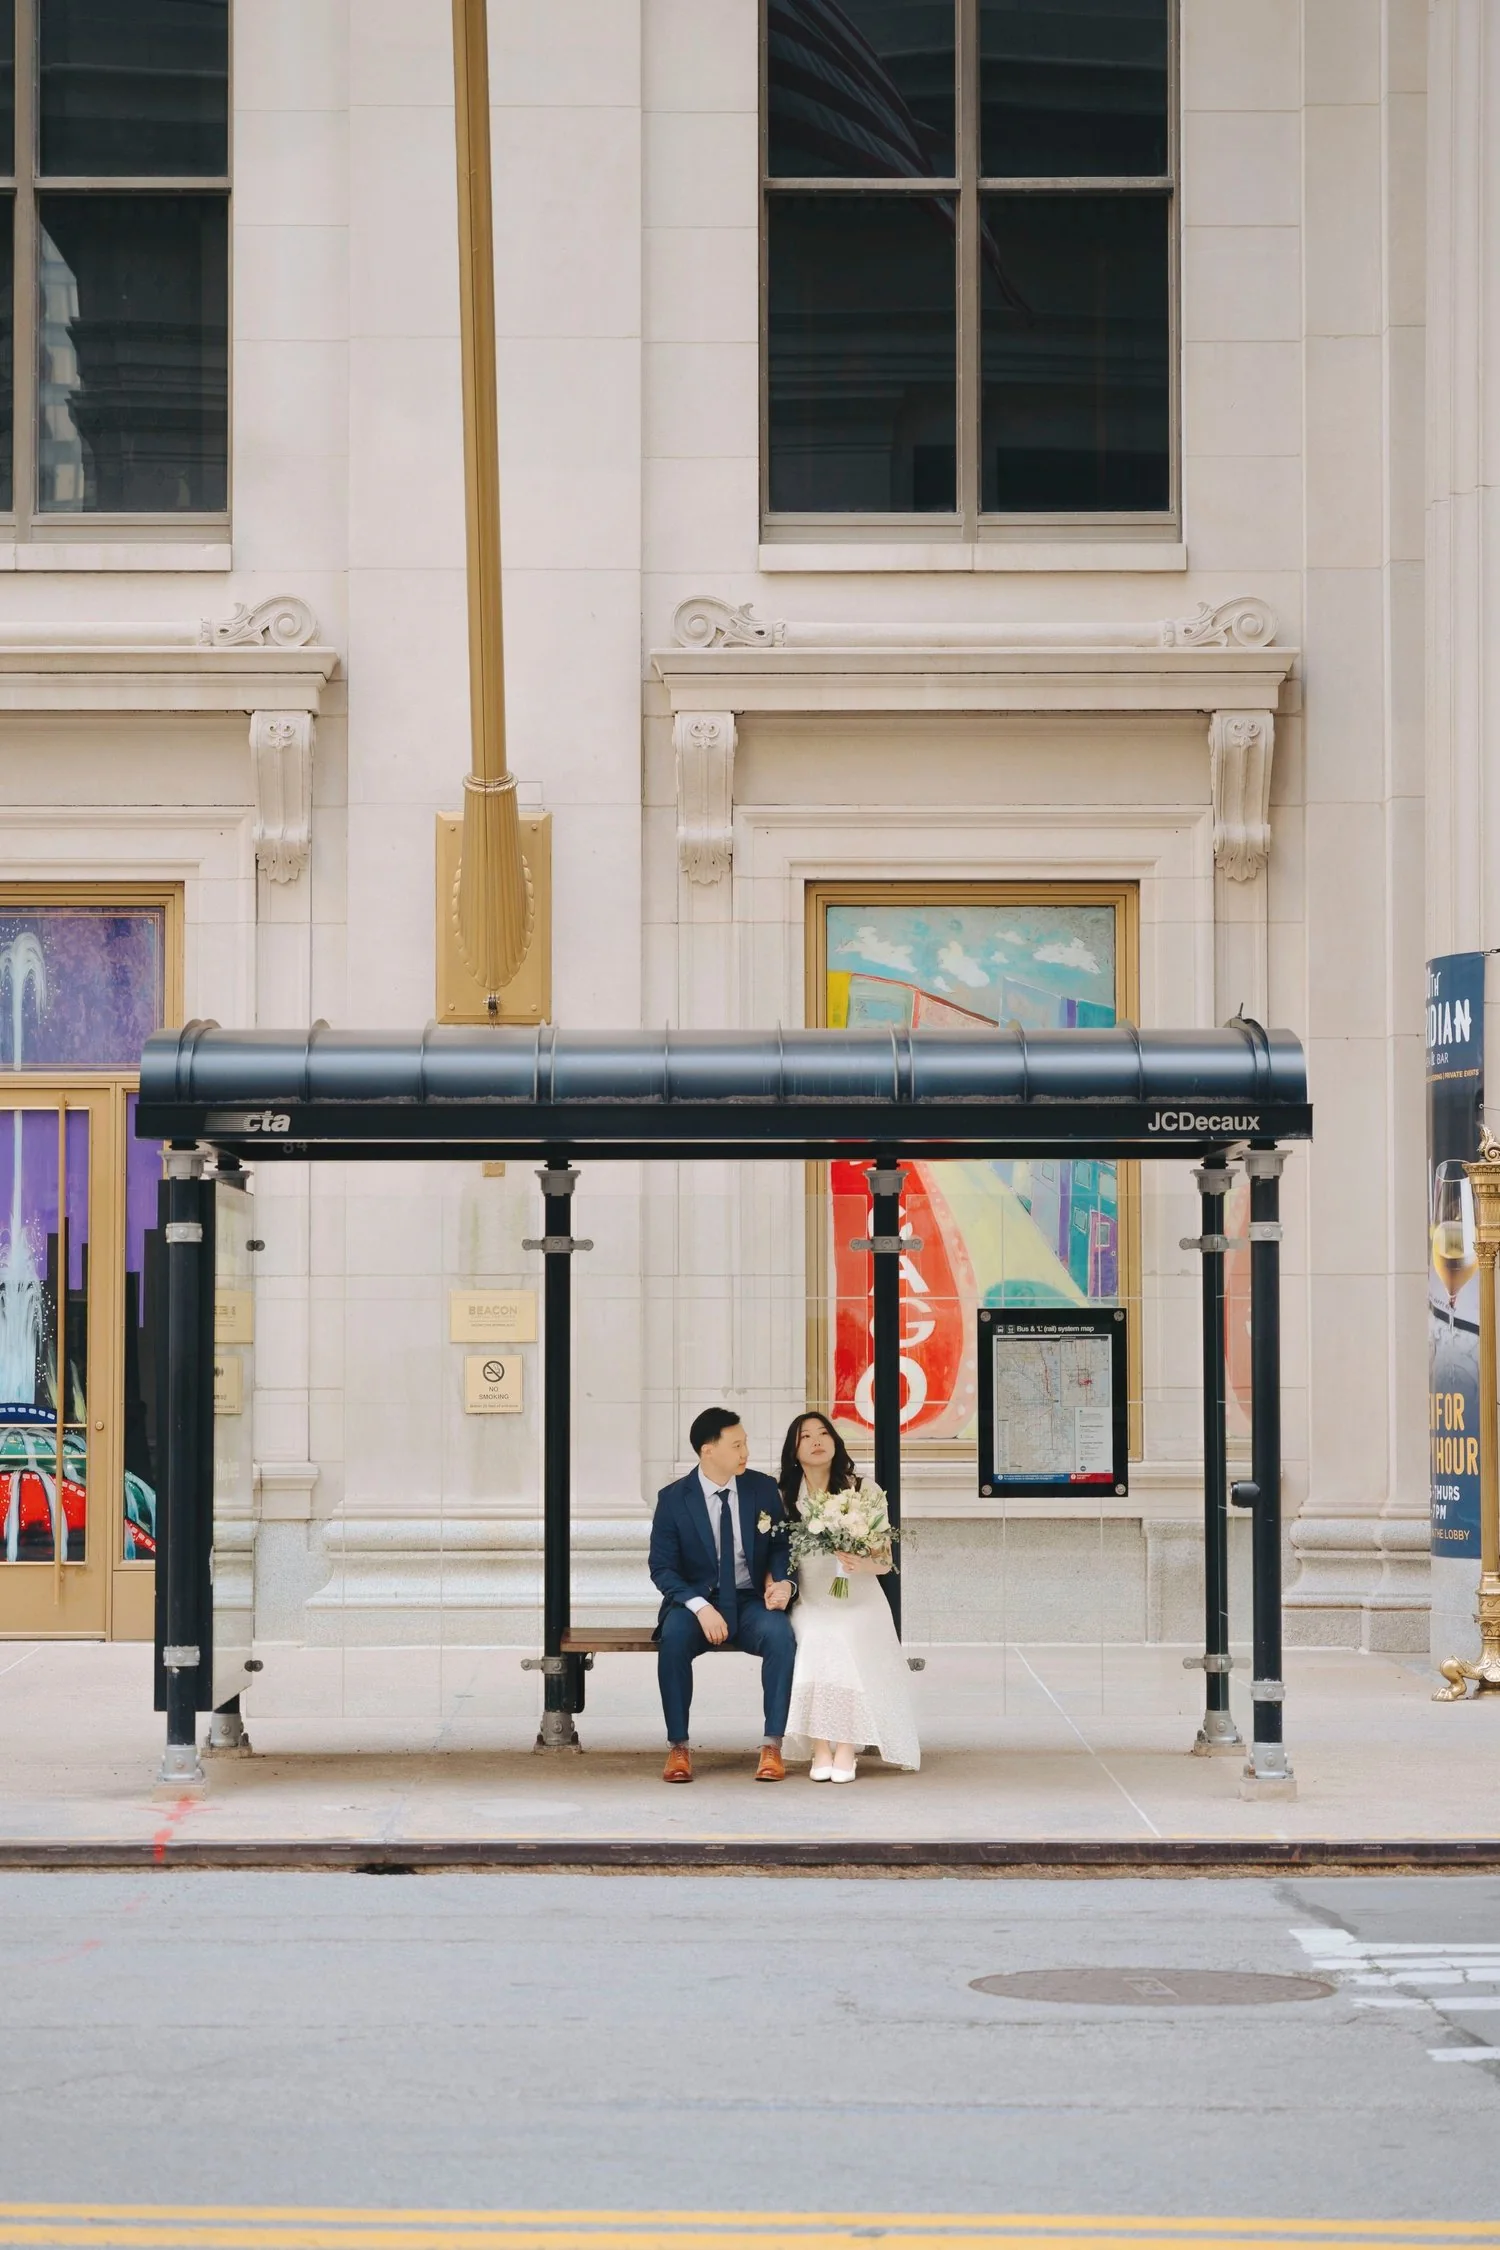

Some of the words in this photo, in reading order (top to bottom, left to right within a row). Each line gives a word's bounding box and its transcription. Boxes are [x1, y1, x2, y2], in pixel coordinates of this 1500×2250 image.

[1436, 1051, 1449, 1065] BAR
[1444, 1070, 1463, 1079] PRIVATE
[1463, 1068, 1480, 1078] EVENTS
[242, 1110, 291, 1132] cta
[1147, 1111, 1260, 1131] JCDecaux
[468, 1305, 518, 1316] BEACON
[1016, 1325, 1029, 1333] Bus
[1030, 1325, 1036, 1333] &
[1044, 1325, 1057, 1334] (rail)
[1057, 1326, 1080, 1334] system
[1080, 1326, 1095, 1334] map
[1435, 1392, 1465, 1431] FOR
[1436, 1437, 1479, 1476] HOUR
[1444, 1529, 1470, 1541] LOBBY
